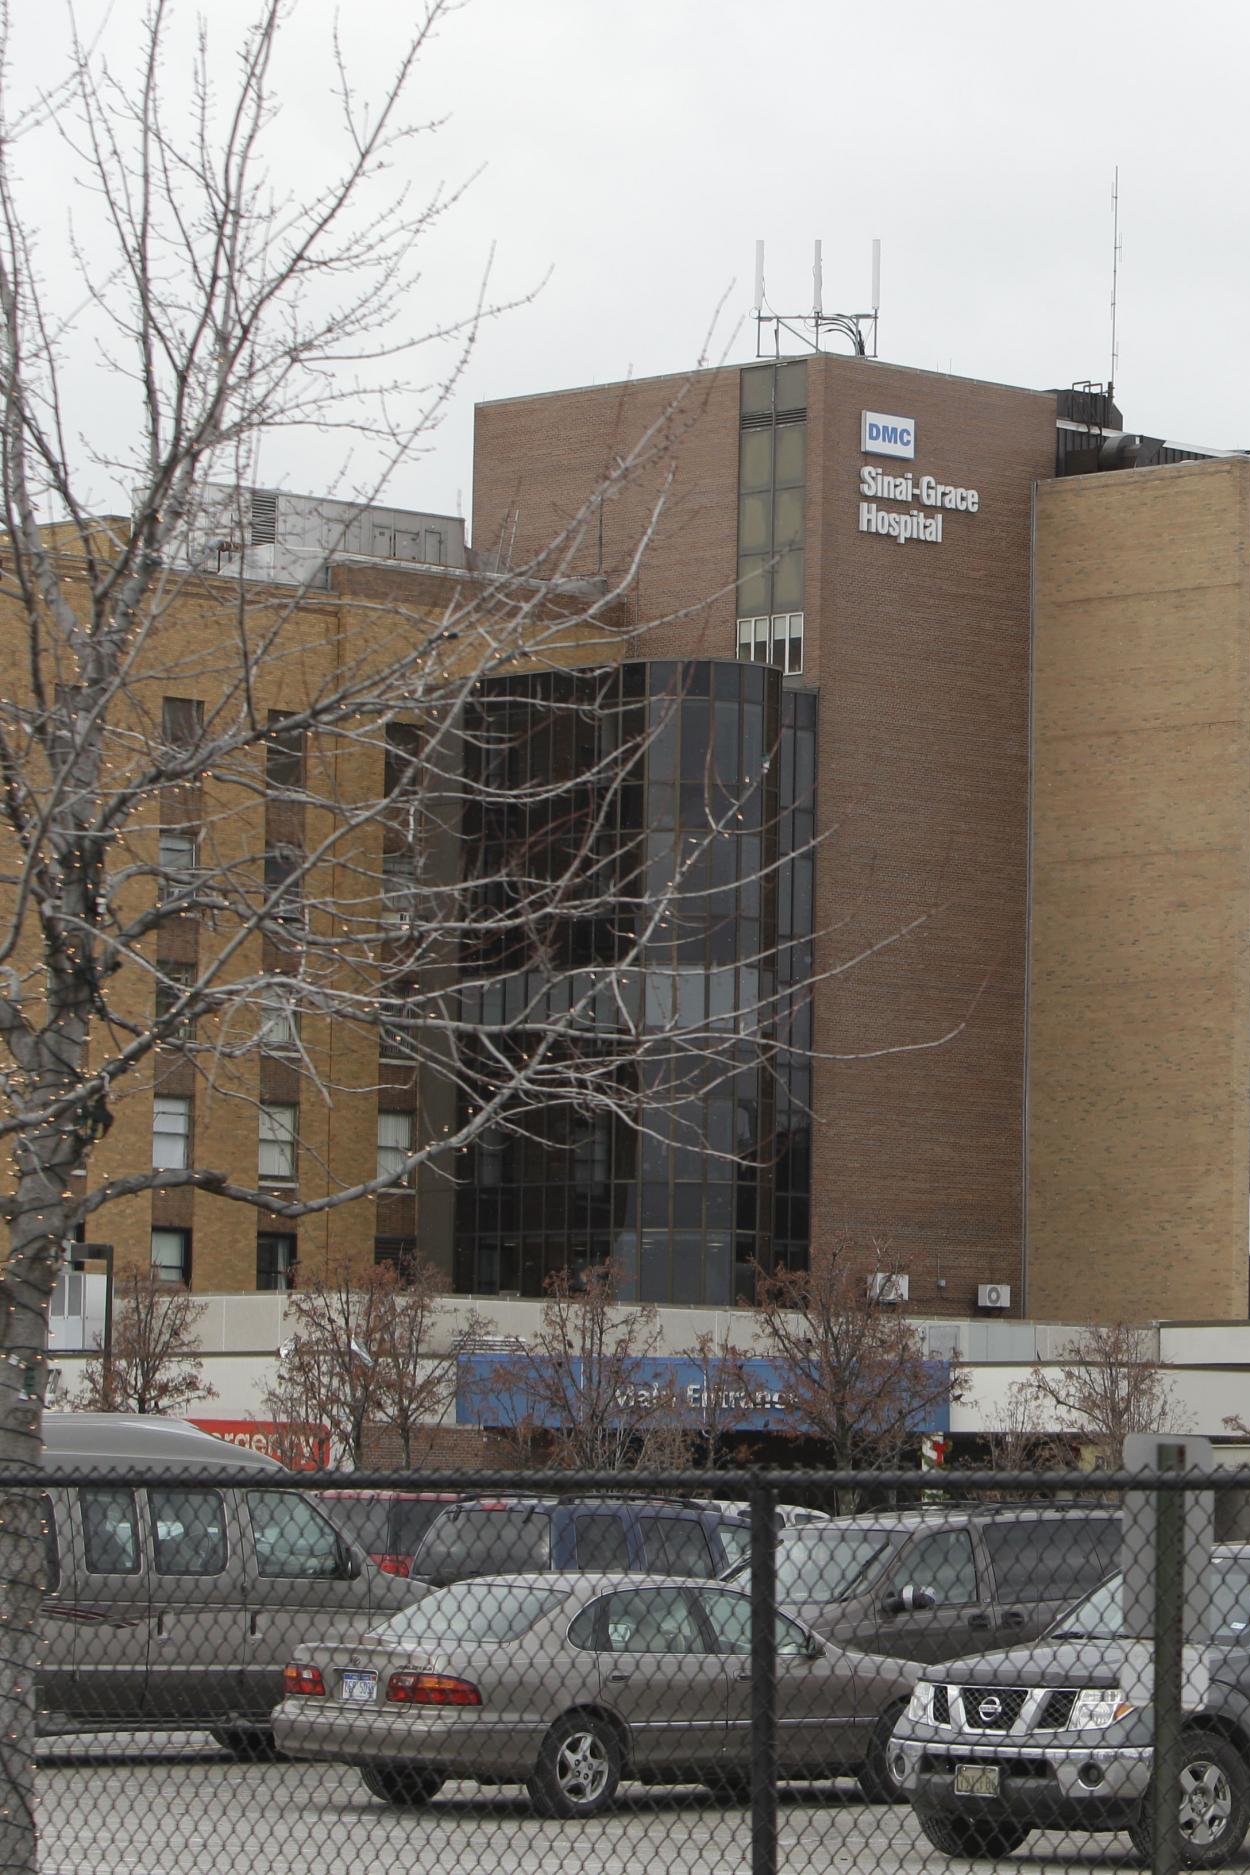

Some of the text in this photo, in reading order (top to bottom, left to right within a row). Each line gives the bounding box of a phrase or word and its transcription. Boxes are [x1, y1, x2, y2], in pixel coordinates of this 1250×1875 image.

[868, 422, 912, 447] DMC
[860, 465, 980, 513] Sinai-Grace
[858, 502, 943, 544] Hospital
[614, 1382, 677, 1408] Mai
